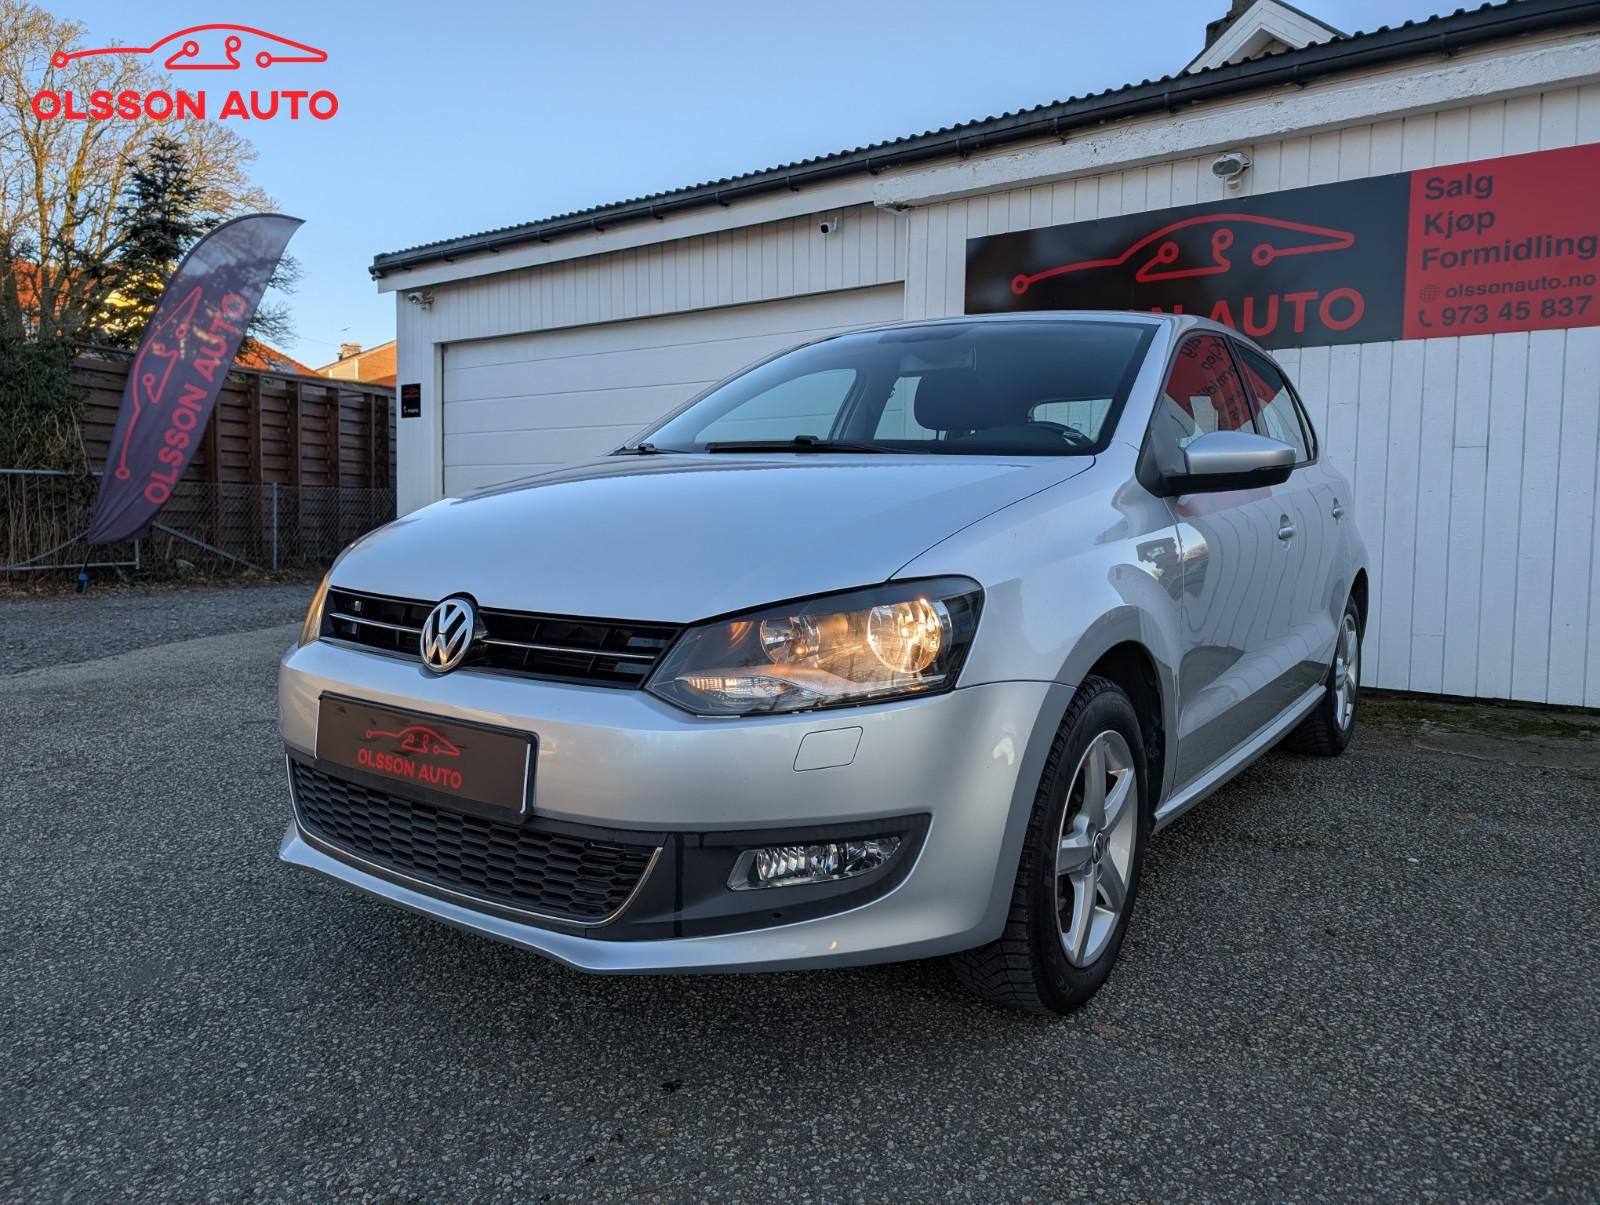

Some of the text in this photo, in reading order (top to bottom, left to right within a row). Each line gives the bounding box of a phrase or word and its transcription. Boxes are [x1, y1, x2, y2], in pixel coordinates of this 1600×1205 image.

[1425, 172, 1493, 200] Salg
[1423, 210, 1496, 239] Kjøp
[1421, 234, 1598, 271] Formidling
[1445, 273, 1597, 298] olssonauto.no
[1209, 288, 1365, 337] AUTO
[1441, 295, 1593, 326] 973 45 837
[144, 292, 247, 504] OLSSON AUTO
[357, 747, 463, 790] OLSSON AUTO
